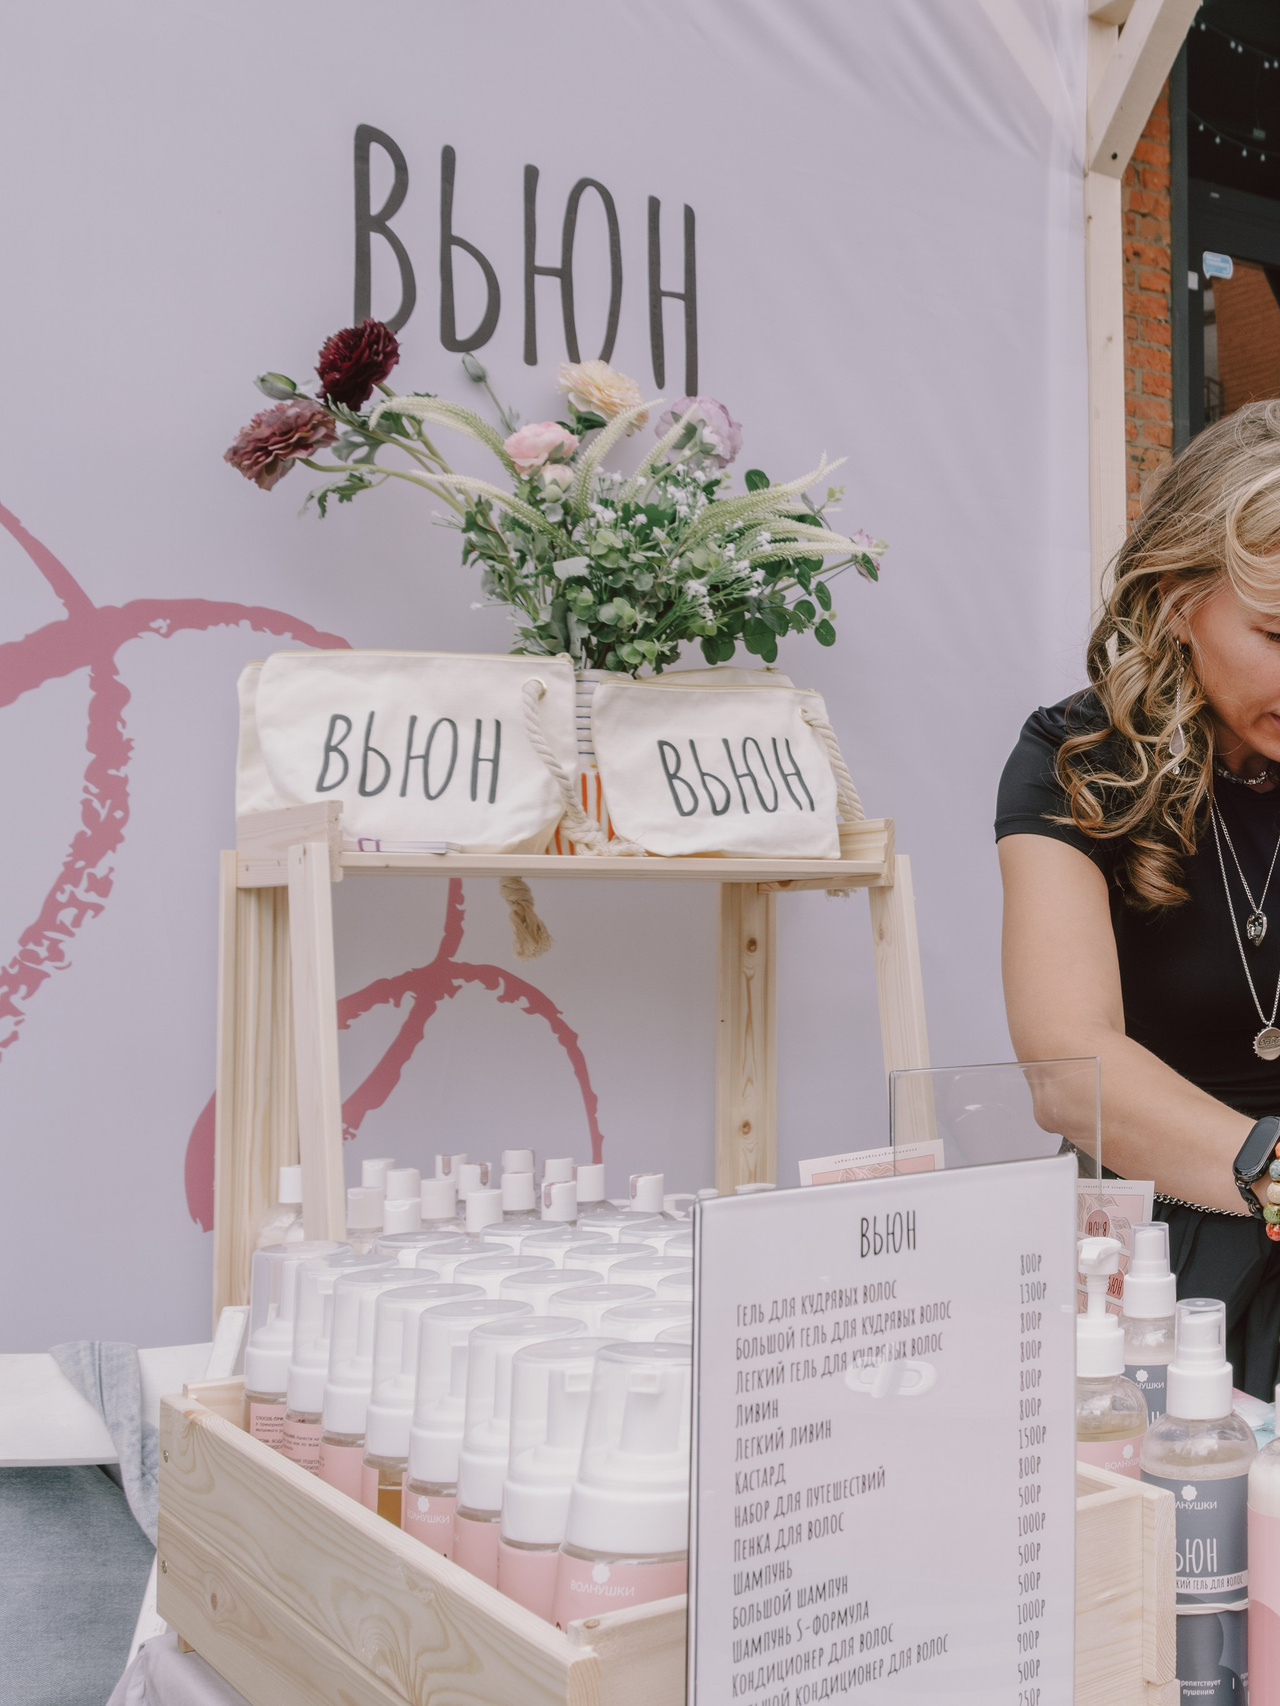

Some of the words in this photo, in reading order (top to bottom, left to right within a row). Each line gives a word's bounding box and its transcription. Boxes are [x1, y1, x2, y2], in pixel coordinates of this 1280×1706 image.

[353, 124, 697, 397] ВЬЮН
[316, 711, 501, 804] ВЬЮН
[658, 736, 816, 816] ВЬЮН
[860, 1209, 917, 1258] ВЬЮН
[1020, 1253, 1042, 1276] 800Р
[737, 1304, 765, 1328] ГЕЛЬ
[768, 1297, 796, 1324] ДЛЯ
[801, 1286, 859, 1316] КУДРЯВЫХ
[862, 1279, 898, 1304] ВОЛОС
[1020, 1281, 1047, 1305] 1300Р
[735, 1326, 795, 1361] БОЛЬШОЙ
[800, 1326, 828, 1348] ГЕЛЬ
[830, 1318, 857, 1344] ДЛЯ
[861, 1308, 916, 1337] КУДРЯВЫХ
[920, 1299, 953, 1326] ВОЛОС
[1020, 1311, 1042, 1334] 800Р
[735, 1361, 785, 1395] ЛЕГКИЙ
[790, 1358, 818, 1383] ГЕЛЬ
[820, 1351, 848, 1378] ДЛЯ
[852, 1339, 907, 1369] КУДРЯВЫХ
[911, 1331, 944, 1357] ВОЛОС
[1020, 1340, 1042, 1363] 800Р
[1019, 1368, 1042, 1392] 800Р
[735, 1398, 779, 1429] ЛИВИН
[1019, 1397, 1042, 1421] 800Р
[735, 1426, 785, 1463] ЛЕГКИЙ
[789, 1419, 832, 1449] ЛИВИН
[1018, 1424, 1047, 1450] 1500Р
[734, 1462, 787, 1496] КАСТАРД
[1018, 1455, 1041, 1480] 800Р
[734, 1499, 770, 1529] НАБОР
[773, 1491, 802, 1521] ДЛЯ
[806, 1465, 886, 1509] ПУТЕШЕСТВИЙ
[1018, 1484, 1041, 1508] 500Р
[1175, 1500, 1218, 1510] ЛНУШКИ
[406, 1508, 451, 1524] ВОЛНУШКИ
[1017, 1511, 1046, 1537] 1000Р
[733, 1533, 771, 1563] ПЕНКА
[774, 1523, 803, 1553] ДЛЯ
[807, 1511, 845, 1542] ВОЛОС
[1018, 1542, 1041, 1567] 500Р
[1175, 1537, 1218, 1575] ЬЮН
[569, 1579, 635, 1597] ВОЛНУШКИ
[732, 1559, 793, 1597] ШАМПУНЬ
[1018, 1571, 1041, 1596] 500Р
[1192, 1579, 1209, 1591] ГЕЛЬ
[1210, 1579, 1225, 1591] ДЛЯ
[1226, 1573, 1244, 1588] ВОЛОС
[732, 1588, 792, 1631] БОЛЬШОЙ
[796, 1574, 849, 1610] ШАМПУН
[1017, 1599, 1046, 1625] 1000Р
[732, 1625, 792, 1665] ШАМПУНЬ
[796, 1600, 870, 1644] S-ФОРМУЛА
[1017, 1630, 1040, 1655] 900Р
[732, 1647, 825, 1699] КОНДИЦИОНЕР
[828, 1636, 855, 1667] ДЛЯ
[859, 1622, 895, 1654] ВОЛОС
[795, 1658, 885, 1706] КОНДИЦИОНЕР
[887, 1648, 913, 1678] ДЛЯ
[915, 1633, 949, 1664] ВОЛОС
[1018, 1659, 1041, 1684] 500Р
[1180, 1679, 1221, 1688] репятствует
[1182, 1688, 1215, 1697] пушению
